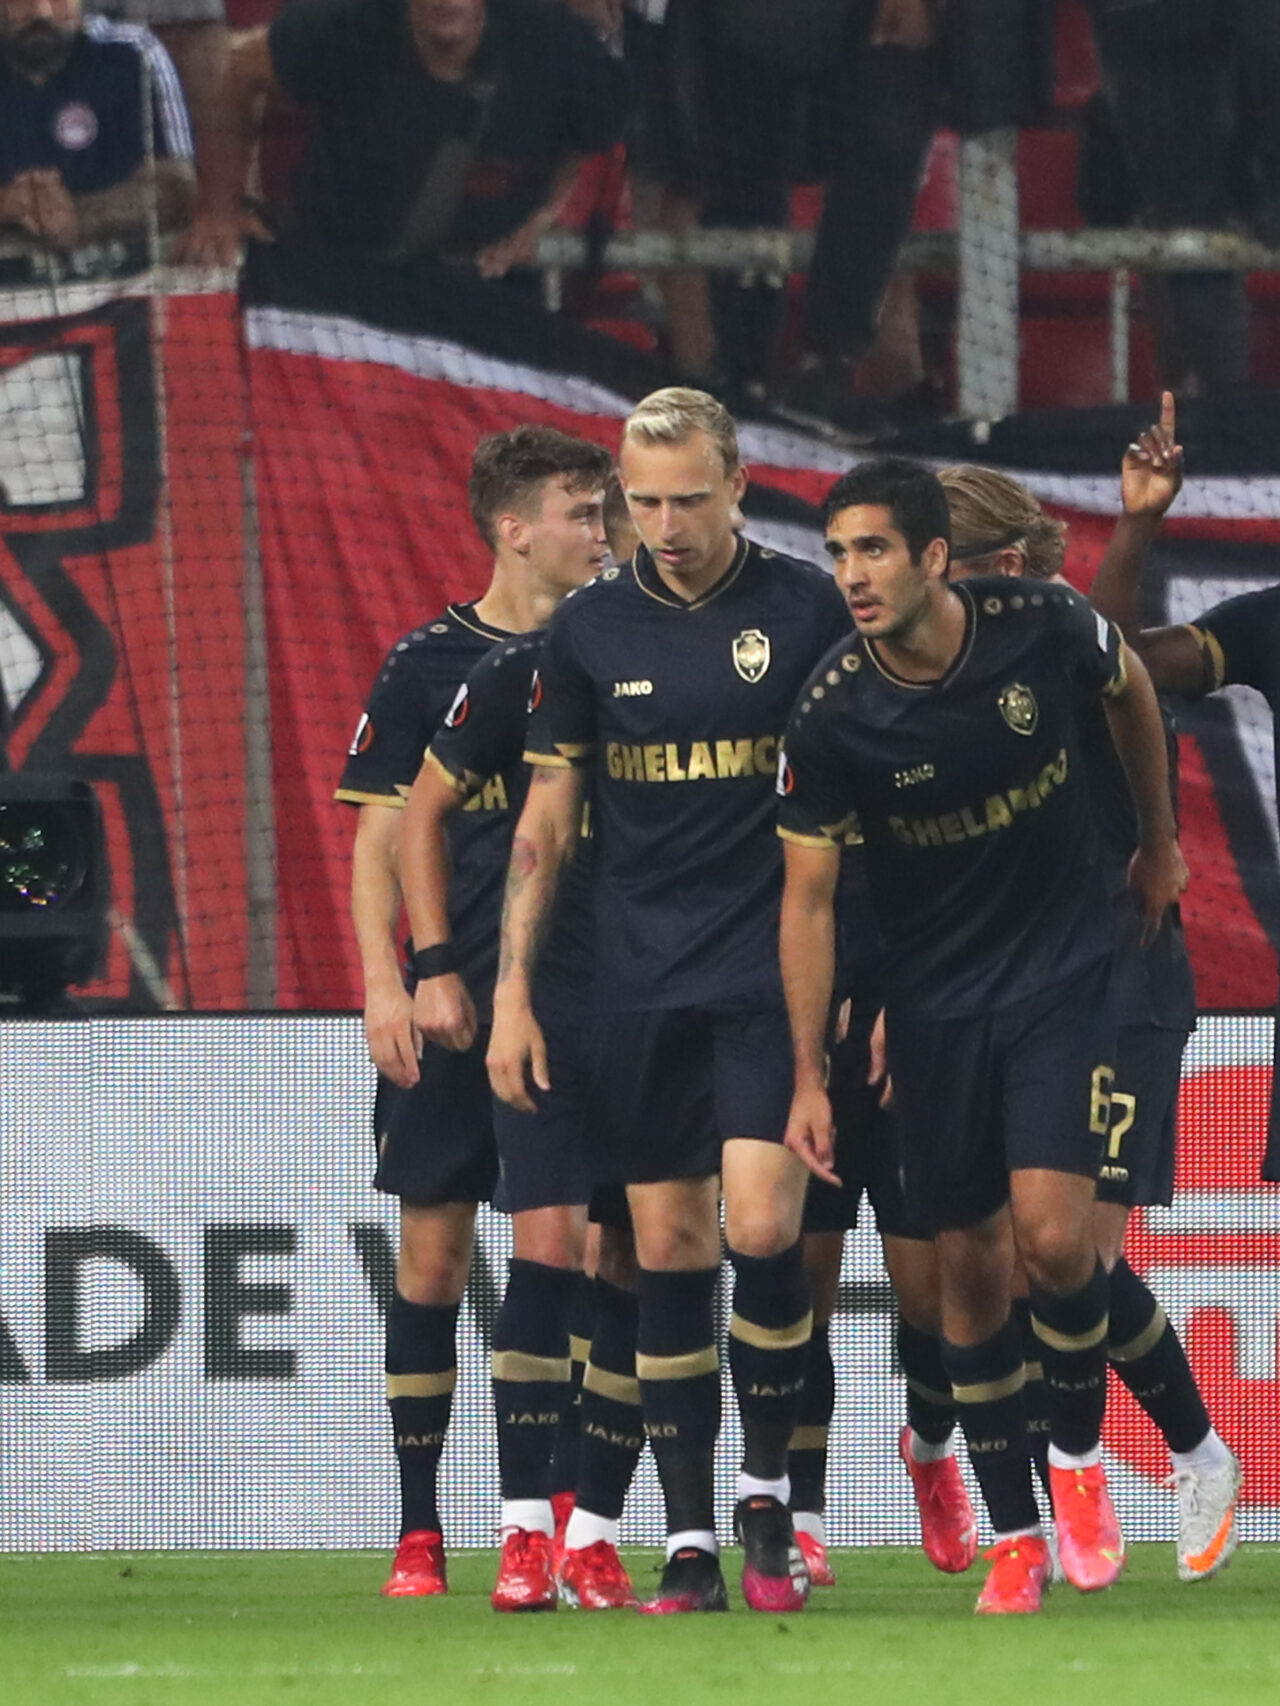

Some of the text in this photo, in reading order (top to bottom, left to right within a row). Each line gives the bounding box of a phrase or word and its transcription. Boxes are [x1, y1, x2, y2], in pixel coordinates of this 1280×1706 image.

[613, 680, 654, 698] JAKO
[606, 735, 785, 783] GHELAMC
[1100, 1165, 1129, 1181] AKO
[0, 1224, 299, 1385] DE
[506, 1412, 559, 1425] JAKO
[586, 1422, 641, 1448] JAKO
[970, 1438, 1008, 1454] AKO
